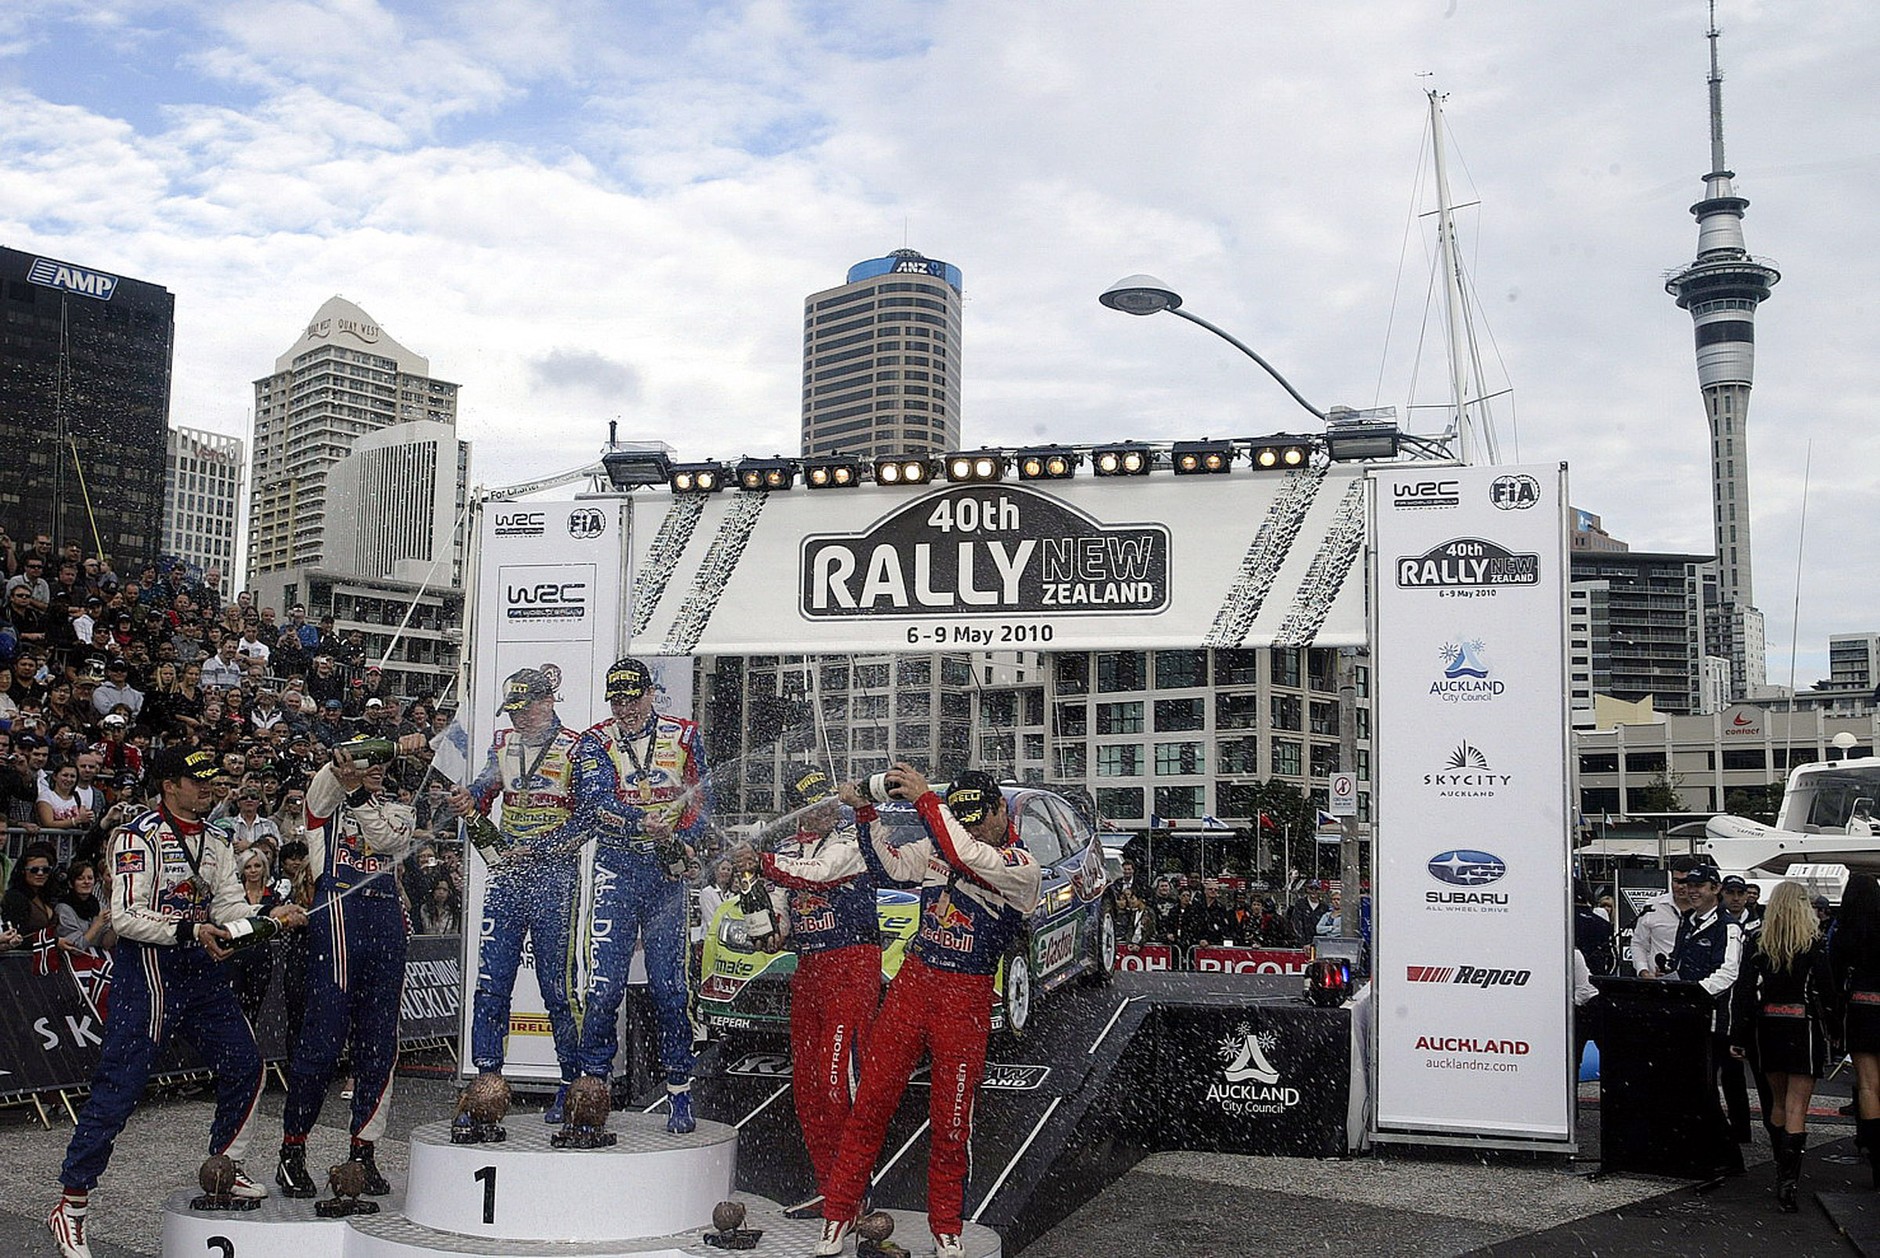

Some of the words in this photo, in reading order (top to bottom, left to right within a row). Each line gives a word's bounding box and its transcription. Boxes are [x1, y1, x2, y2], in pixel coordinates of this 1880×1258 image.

[896, 261, 928, 273] ANZ
[53, 266, 112, 296] AMP
[338, 318, 358, 331] QUAY
[361, 324, 379, 337] WEST
[1393, 480, 1459, 497] WRC
[495, 513, 545, 526] WRC
[927, 497, 1020, 532] 40th
[1445, 543, 1483, 557] 40th
[812, 539, 1038, 609] RALLY
[1042, 536, 1153, 581] NEW
[1400, 559, 1490, 585] RALLY
[1490, 557, 1535, 575] NEW
[1490, 573, 1534, 584] ZEALAND
[507, 583, 586, 604] WRC
[1041, 582, 1153, 605] ZEALAND
[1457, 590, 1474, 598] May
[1475, 589, 1497, 598] 2010
[953, 626, 994, 646] May
[1000, 624, 1053, 642] 2010
[1429, 681, 1505, 695] AUCKLAND
[1442, 692, 1459, 703] City
[1461, 692, 1492, 702] Council
[1424, 774, 1511, 786] SKYCITY
[1425, 891, 1509, 905] SUBARU
[806, 911, 835, 933] Bull
[942, 930, 973, 952] Bull
[1453, 965, 1531, 988] Repco
[1415, 1036, 1530, 1055] AUCKLAND
[1425, 1058, 1518, 1073] aucklandnz.com
[1206, 1084, 1300, 1107] AUCKLAND
[1222, 1100, 1242, 1114] City
[1245, 1101, 1286, 1114] Council
[474, 1165, 497, 1224] 1
